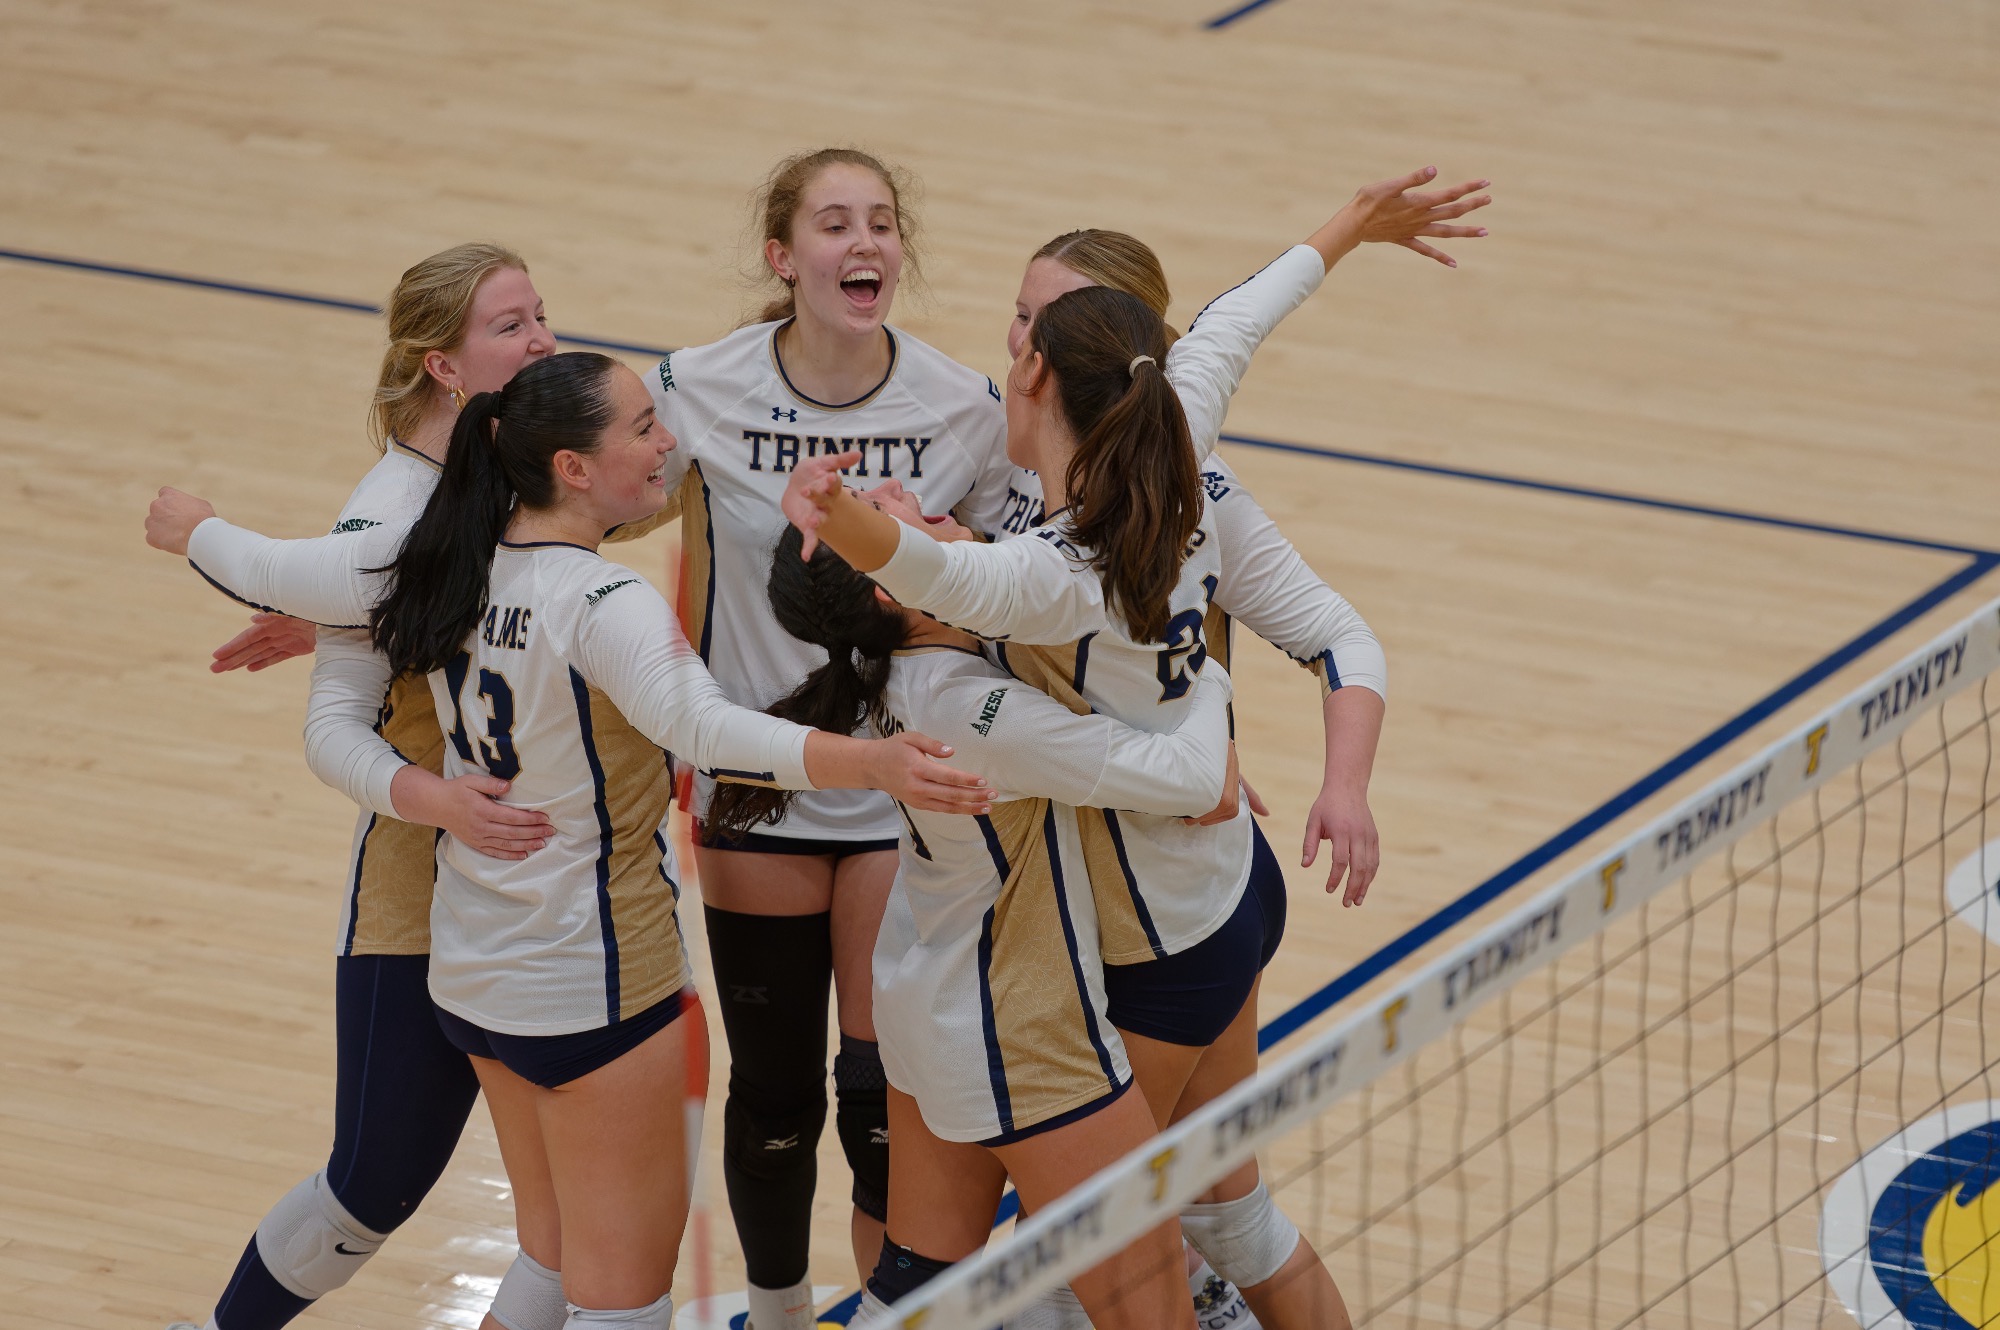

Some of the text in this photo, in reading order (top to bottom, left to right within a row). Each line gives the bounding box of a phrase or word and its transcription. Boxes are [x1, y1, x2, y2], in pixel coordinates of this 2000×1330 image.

[445, 648, 523, 783] 13
[1657, 761, 1772, 872] TRINITY
[1806, 720, 1829, 778] T
[1860, 636, 1967, 739] TRINITY
